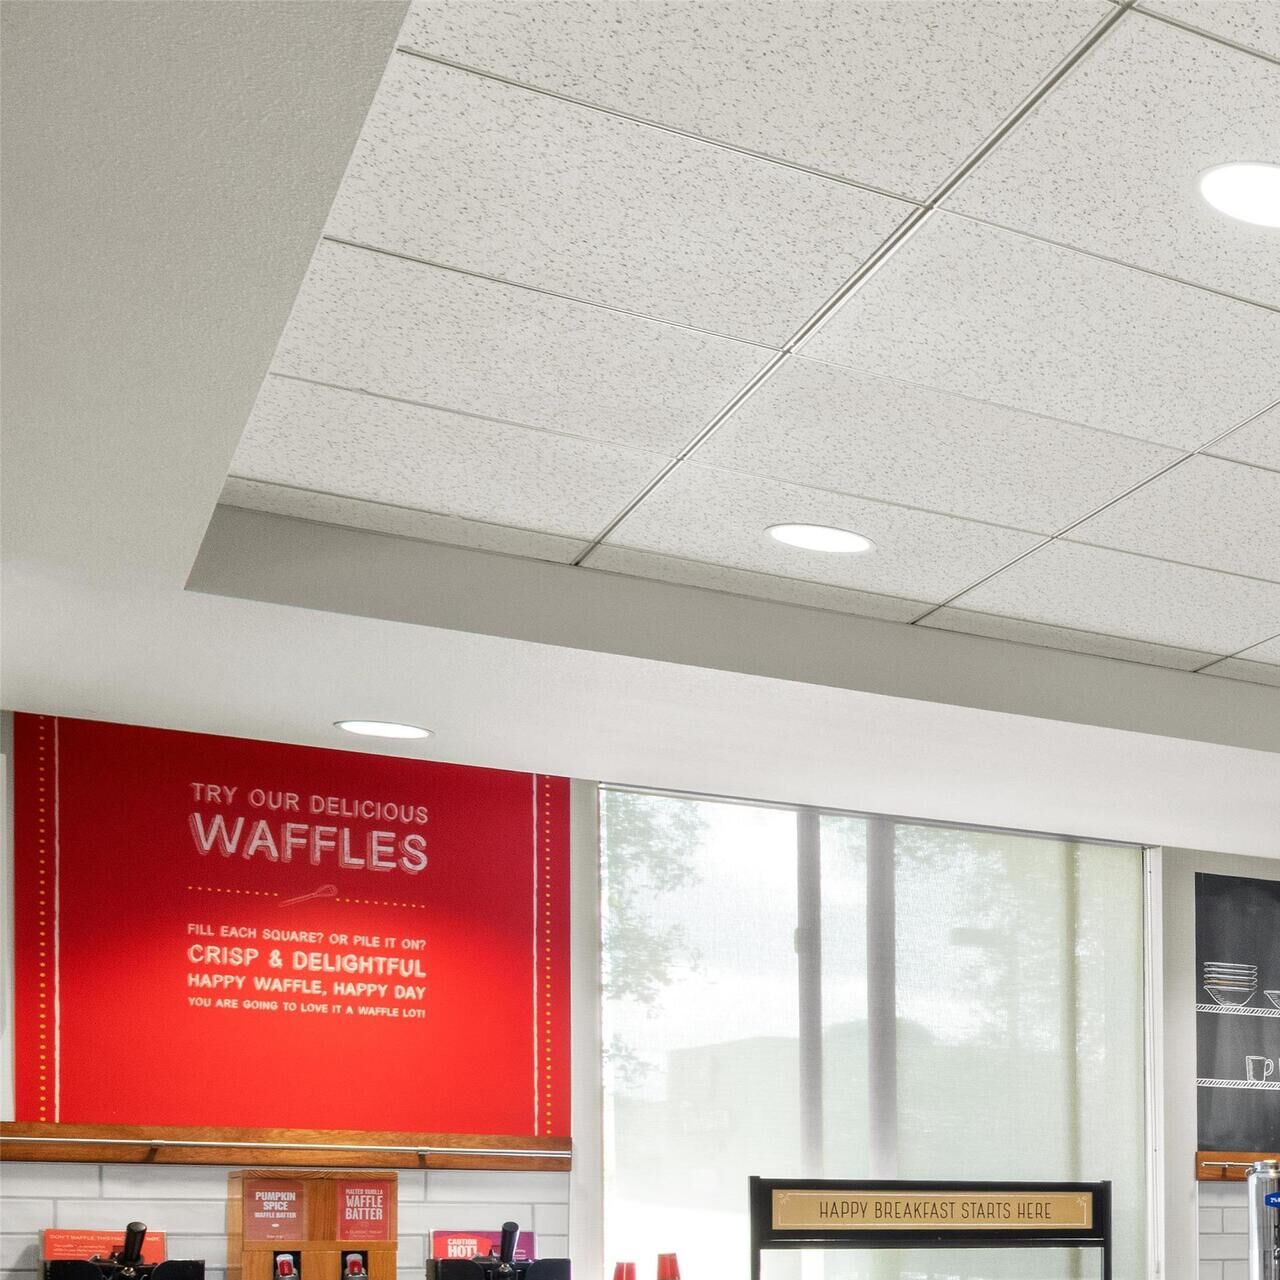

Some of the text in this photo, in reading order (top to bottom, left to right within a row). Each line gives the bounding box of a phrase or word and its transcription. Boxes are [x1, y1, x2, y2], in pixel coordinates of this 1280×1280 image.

[191, 782, 428, 825] TRY OUR DELICIOUS
[188, 812, 428, 875] WAFFLES
[188, 923, 427, 951] FILL EACH SQUARE? OR PILE IT ON?
[188, 943, 427, 978] CRISP & DELIGHTFUL
[188, 973, 426, 1000] HAPPY WAFFLE, HAPPY DAY
[188, 997, 426, 1019] YOU ARE GOING TO LOVE IT A WAFFLE LOT!
[255, 1192, 296, 1201] PUMPKIN
[263, 1202, 288, 1211] SPICE
[346, 1195, 383, 1208] WAFFLE
[345, 1208, 383, 1220] BATTER
[819, 1201, 1052, 1219] HAPPY BREAKFAST STARTS HERE
[448, 1246, 477, 1257] HOT!
